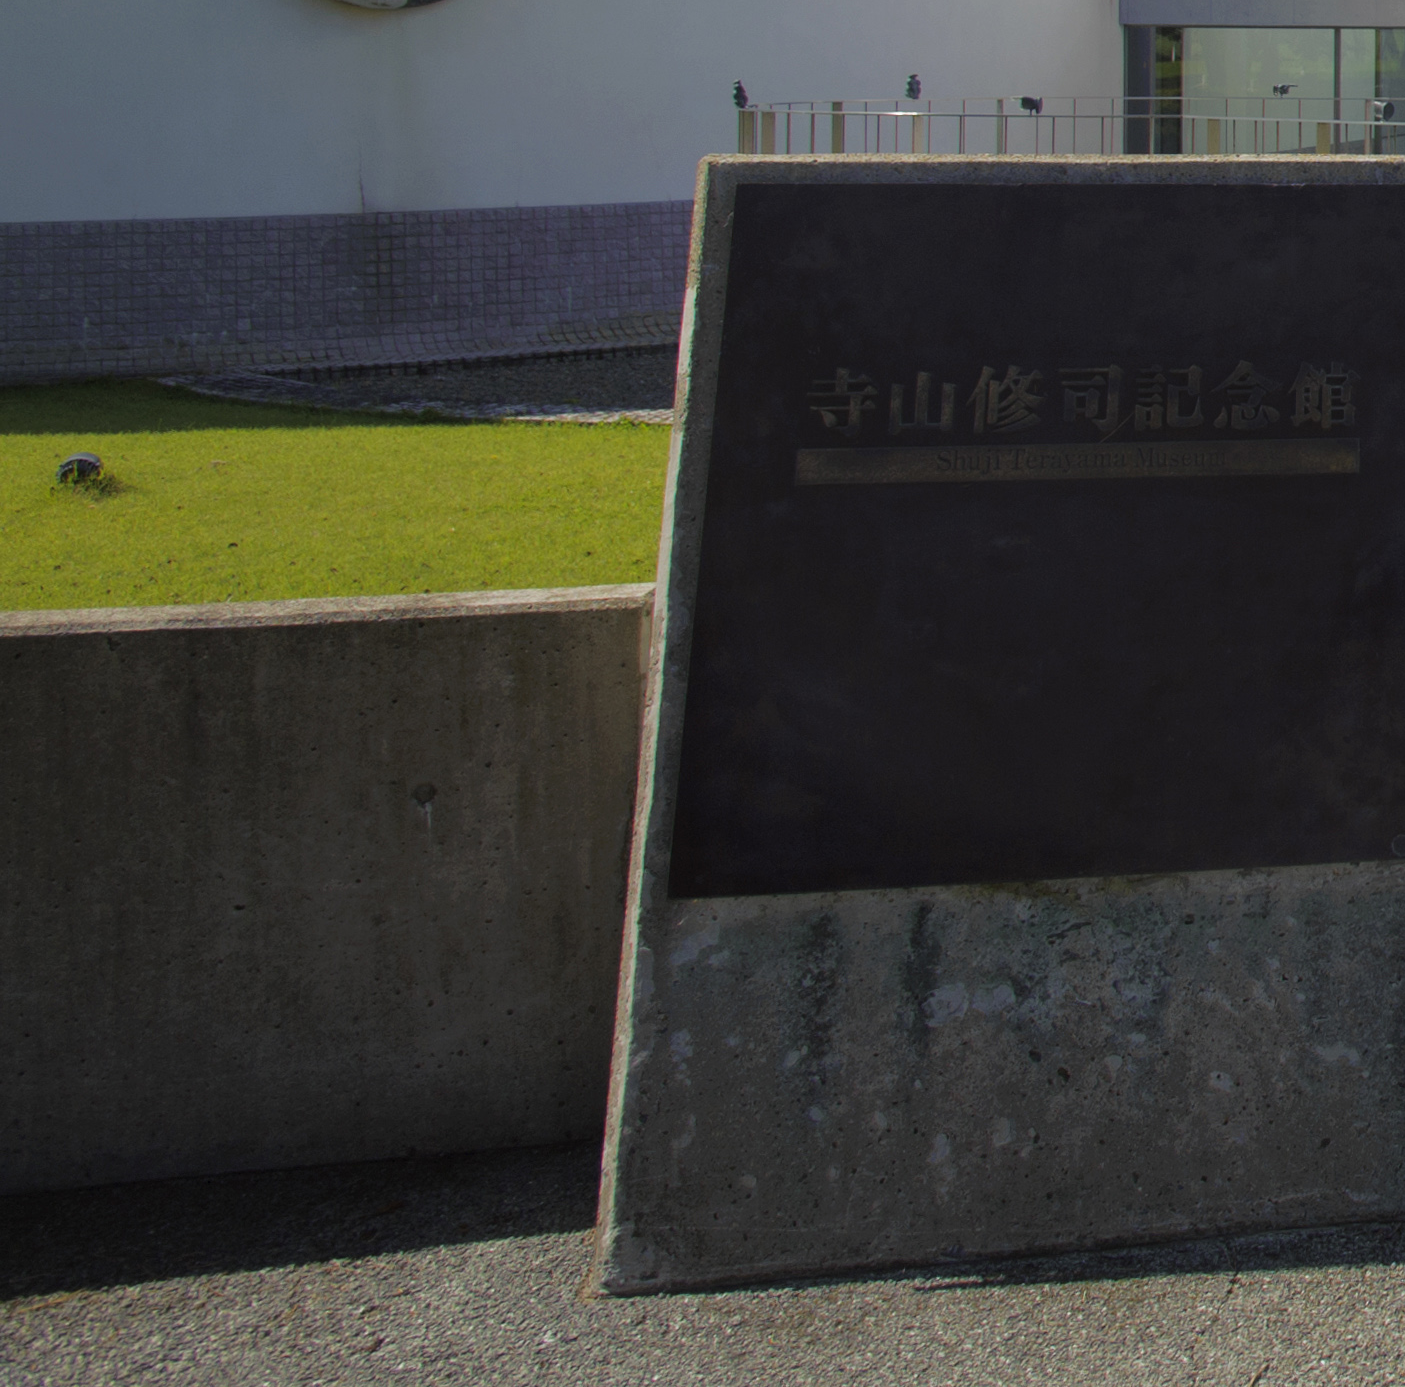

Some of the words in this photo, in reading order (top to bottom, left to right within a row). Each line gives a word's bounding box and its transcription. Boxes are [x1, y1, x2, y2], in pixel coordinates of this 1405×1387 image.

[805, 360, 1362, 438] 寺山修司記念館
[936, 448, 1003, 473] Shuji
[1008, 447, 1128, 474] Terayama
[1137, 446, 1227, 469] Museum
